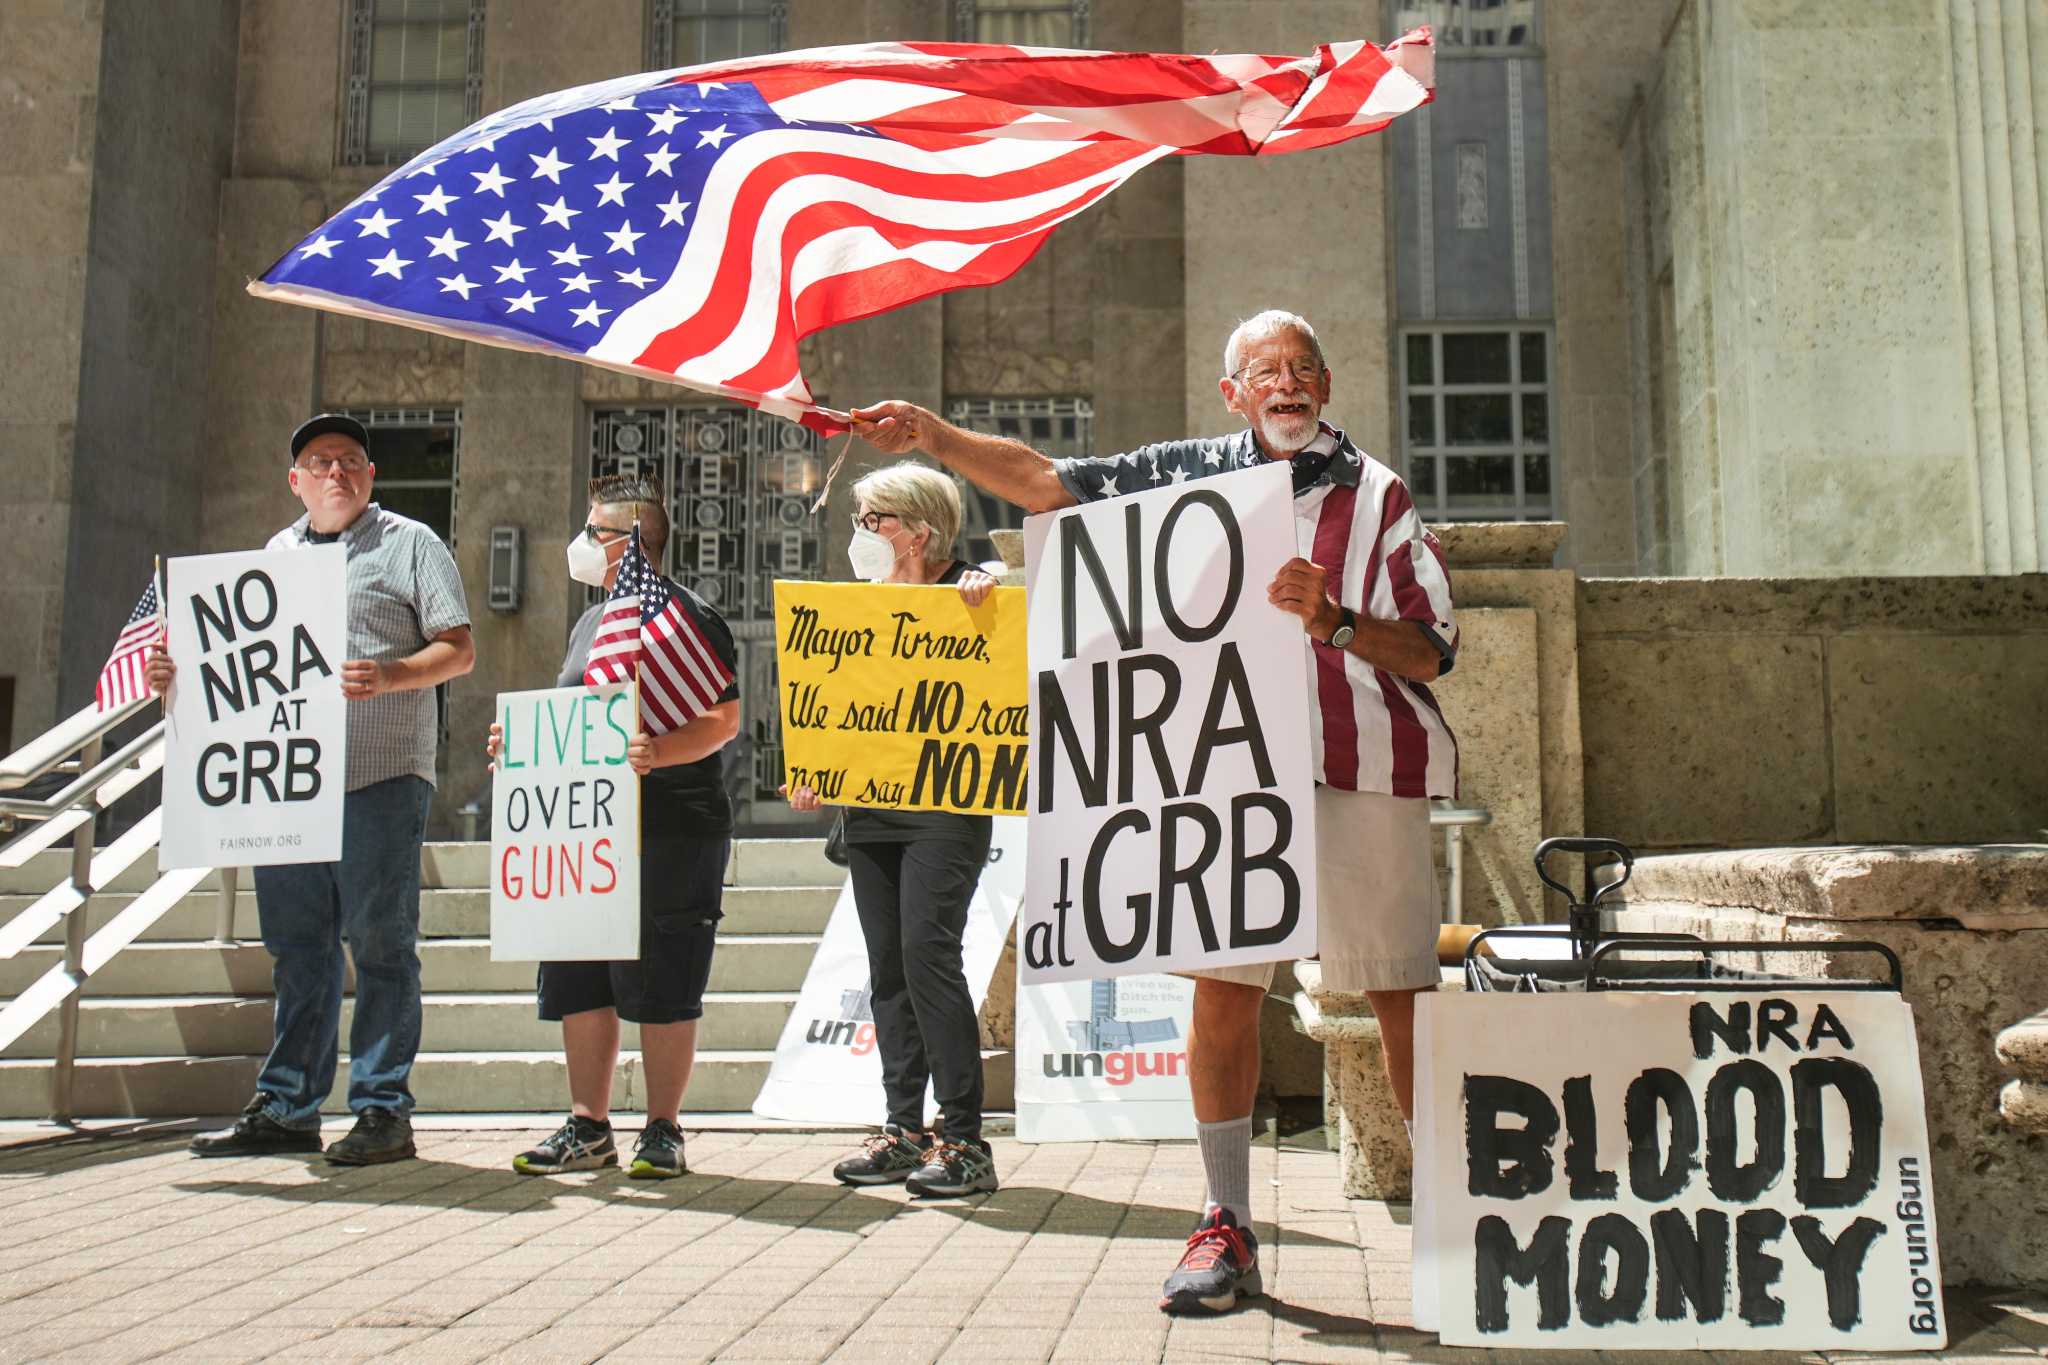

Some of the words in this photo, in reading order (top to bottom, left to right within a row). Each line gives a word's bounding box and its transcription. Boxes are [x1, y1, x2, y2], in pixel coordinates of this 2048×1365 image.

[1060, 489, 1244, 659] NO
[190, 569, 278, 653] NO
[785, 605, 875, 673] Mayor
[891, 612, 991, 664] Turner,
[199, 623, 333, 723] NRA
[789, 681, 829, 729] We
[837, 688, 903, 732] said
[906, 679, 964, 734] NO
[269, 698, 307, 732] AT
[504, 693, 628, 769] LIVES
[1038, 641, 1277, 813] NRA
[196, 738, 321, 807] GRB
[507, 779, 615, 832] OVER
[855, 778, 905, 808] say
[909, 739, 981, 808] NO
[219, 834, 302, 849] FAIRNOW.ORG
[501, 838, 616, 900] GUNS
[1024, 857, 1075, 968] at
[1082, 792, 1301, 963] GRB
[1690, 999, 1854, 1059] NRA
[1043, 1052, 1188, 1086] ungun
[1464, 1057, 1883, 1209] BLOOD
[1475, 1208, 1888, 1334] MONEY
[1897, 1157, 1939, 1336] ungun.org
